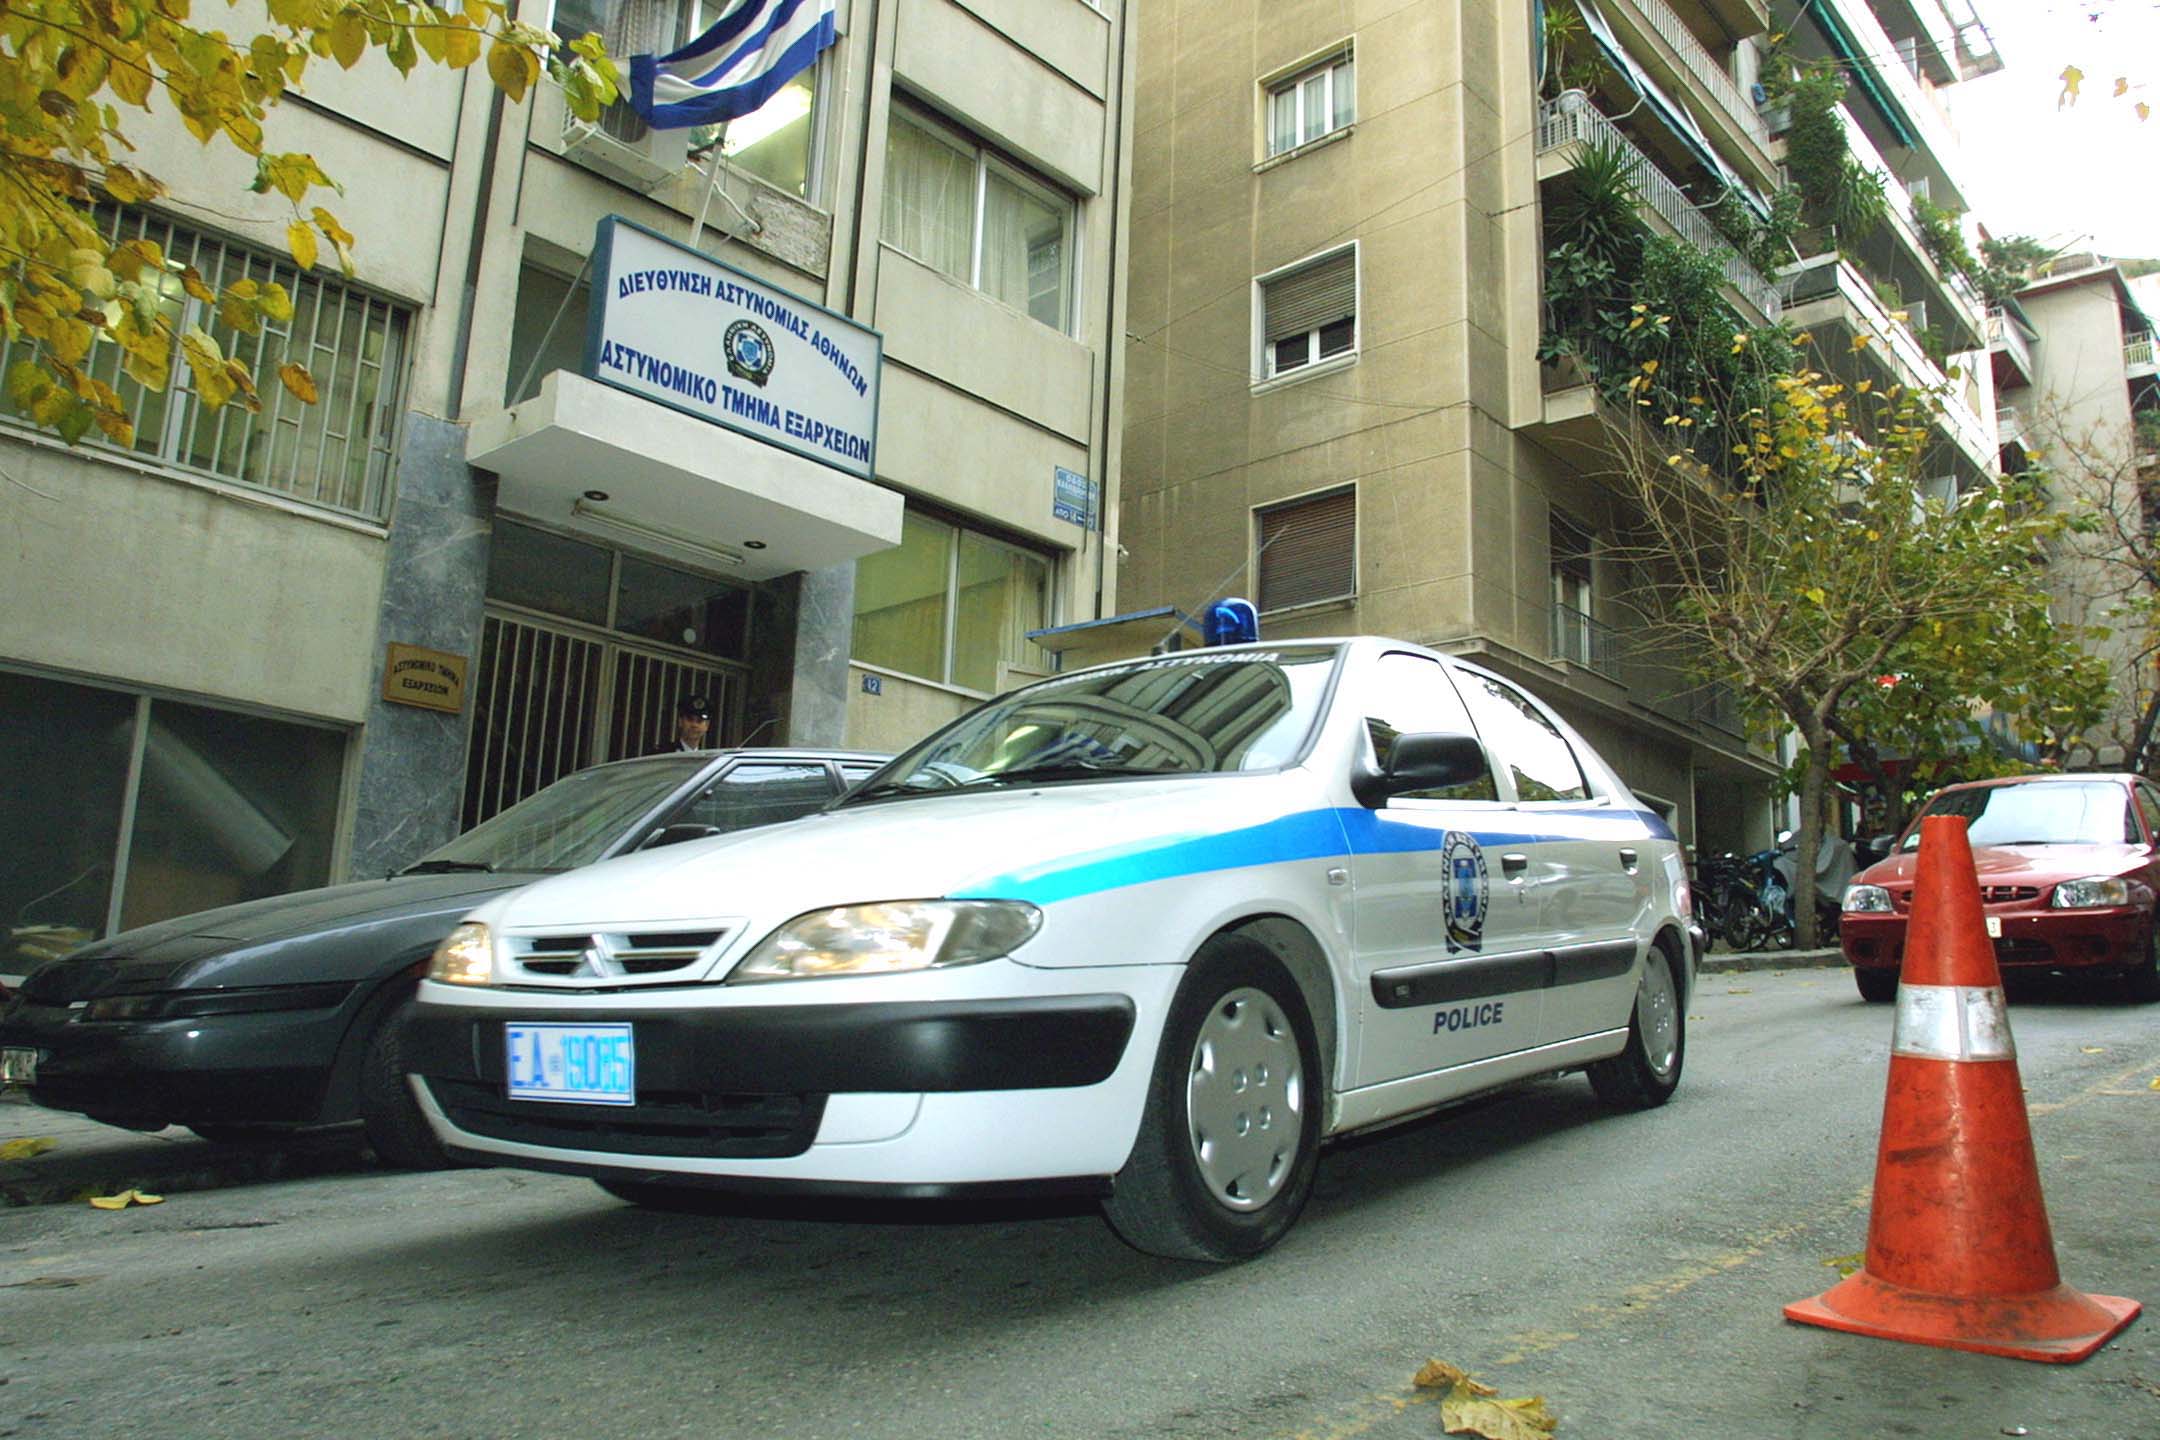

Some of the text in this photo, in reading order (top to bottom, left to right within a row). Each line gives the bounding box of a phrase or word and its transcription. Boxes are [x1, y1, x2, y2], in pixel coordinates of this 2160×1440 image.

[618, 269, 868, 398] ΔΙΕΥΘΥΝΣΗ ΑΣΤΥΝΟΜΙΑΣ ΑΘΗΝΩΝ
[601, 340, 870, 464] ΑΣΤΥΝΟΜΙΚΟ ΤΜΗΜΑ ΕΞΑΡΧΕΙΩΝ
[1433, 1002, 1504, 1035] POLICE
